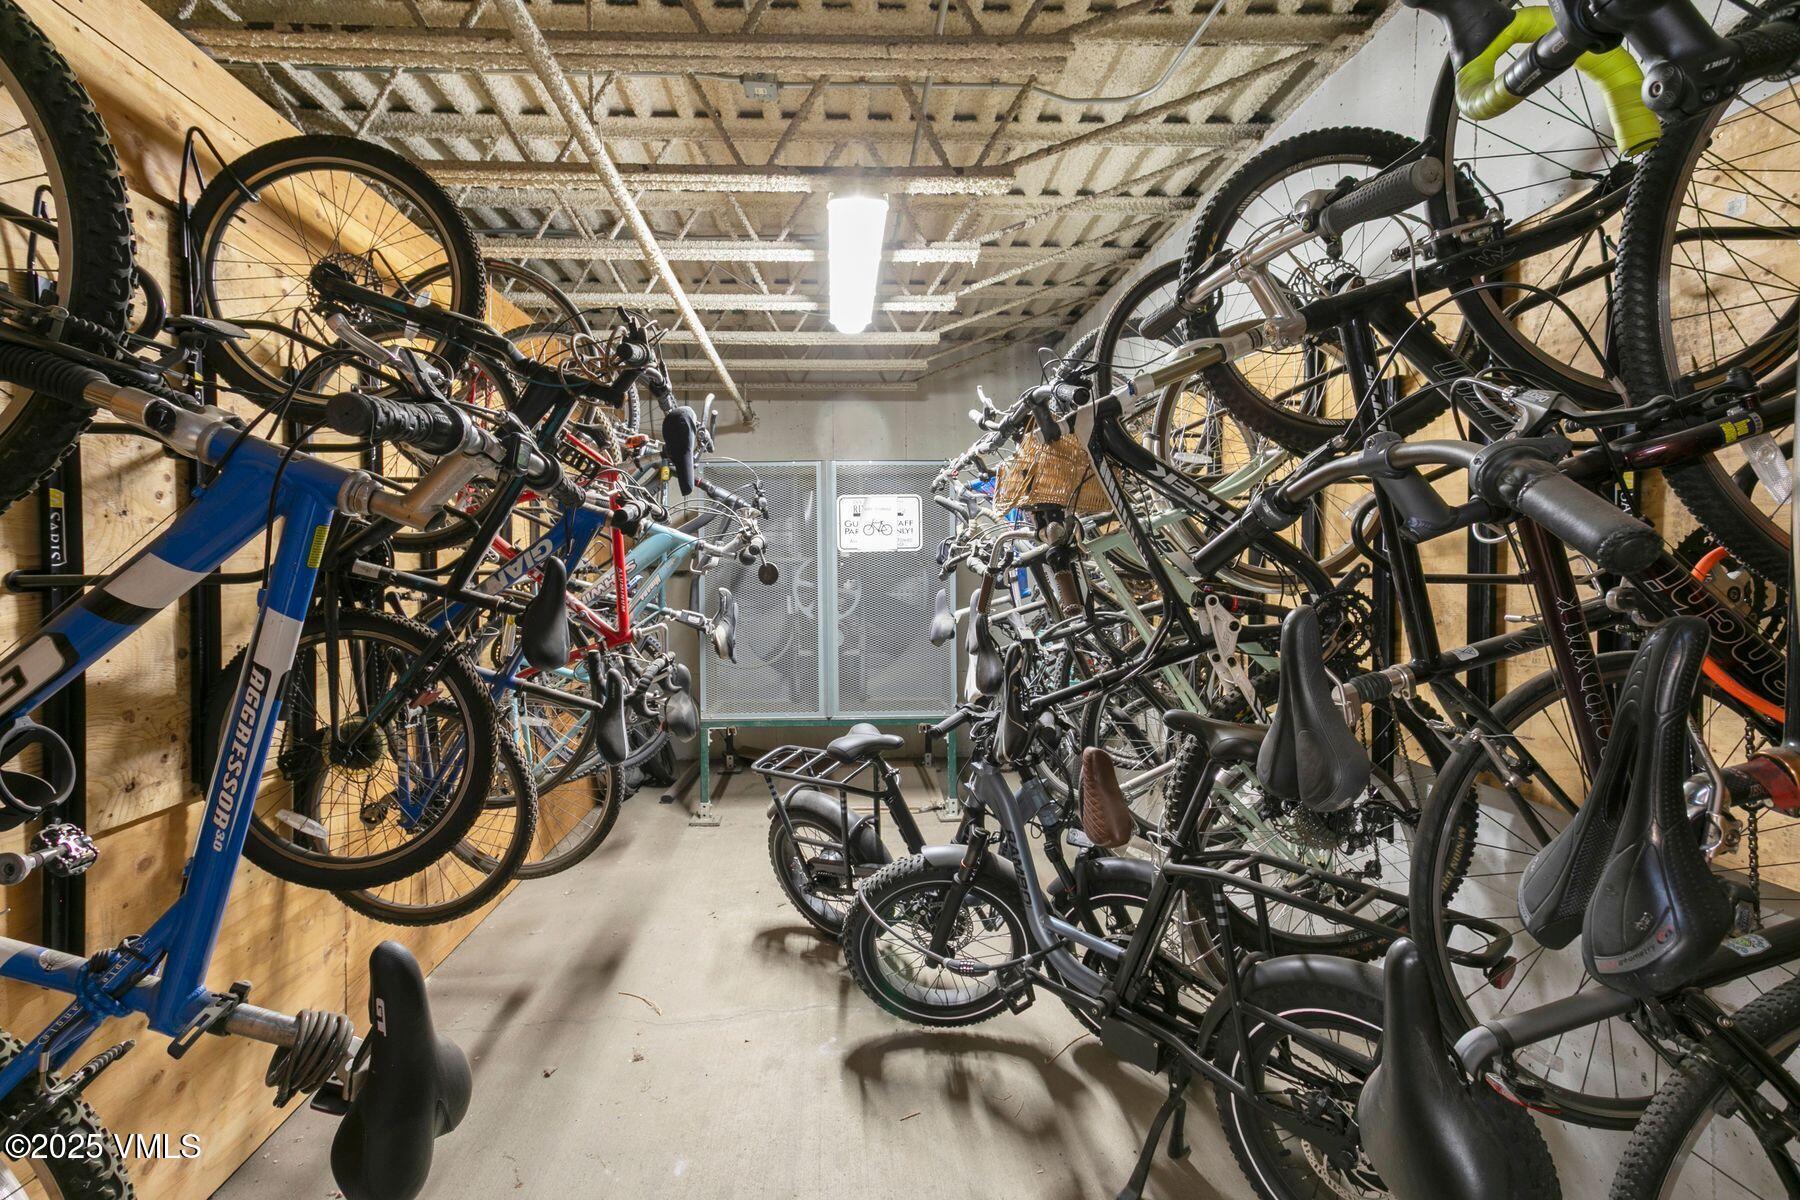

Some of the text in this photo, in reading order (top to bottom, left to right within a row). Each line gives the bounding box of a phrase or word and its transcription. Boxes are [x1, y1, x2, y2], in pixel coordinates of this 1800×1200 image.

[1146, 464, 1241, 528] TREK
[487, 537, 555, 596] GIAN
[212, 667, 267, 831] AGGRESSOR
[375, 996, 387, 1038] GT
